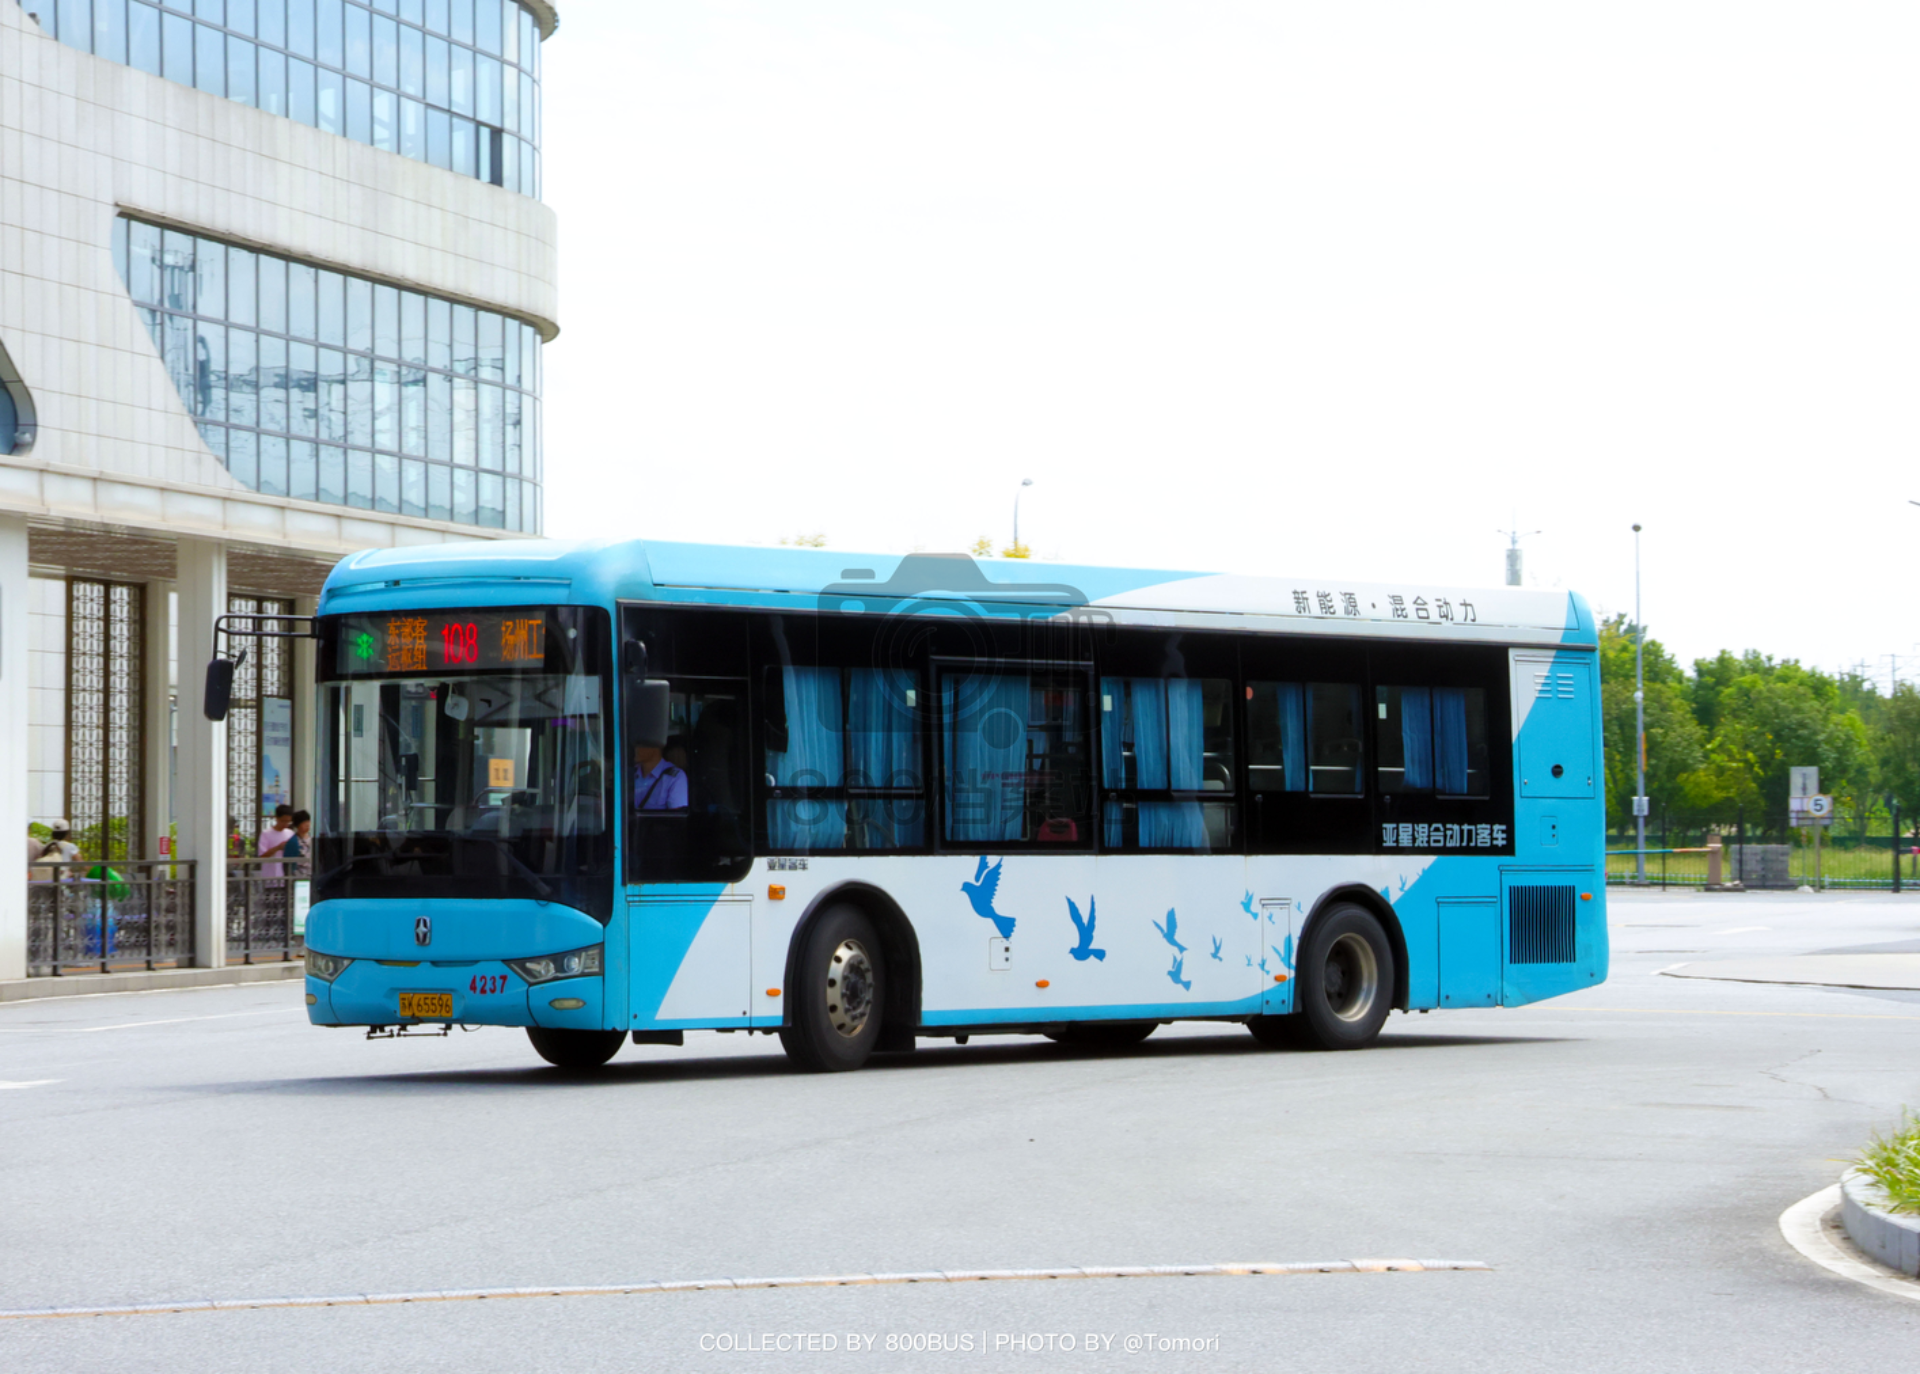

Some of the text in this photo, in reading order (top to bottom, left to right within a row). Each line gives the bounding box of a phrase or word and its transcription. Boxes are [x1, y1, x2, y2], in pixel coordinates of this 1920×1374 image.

[440, 622, 478, 664] 108
[501, 619, 546, 662] 扬州工
[1813, 798, 1823, 812] 5
[1382, 823, 1507, 847] 亚星混合动力客车
[469, 974, 508, 995] 4237
